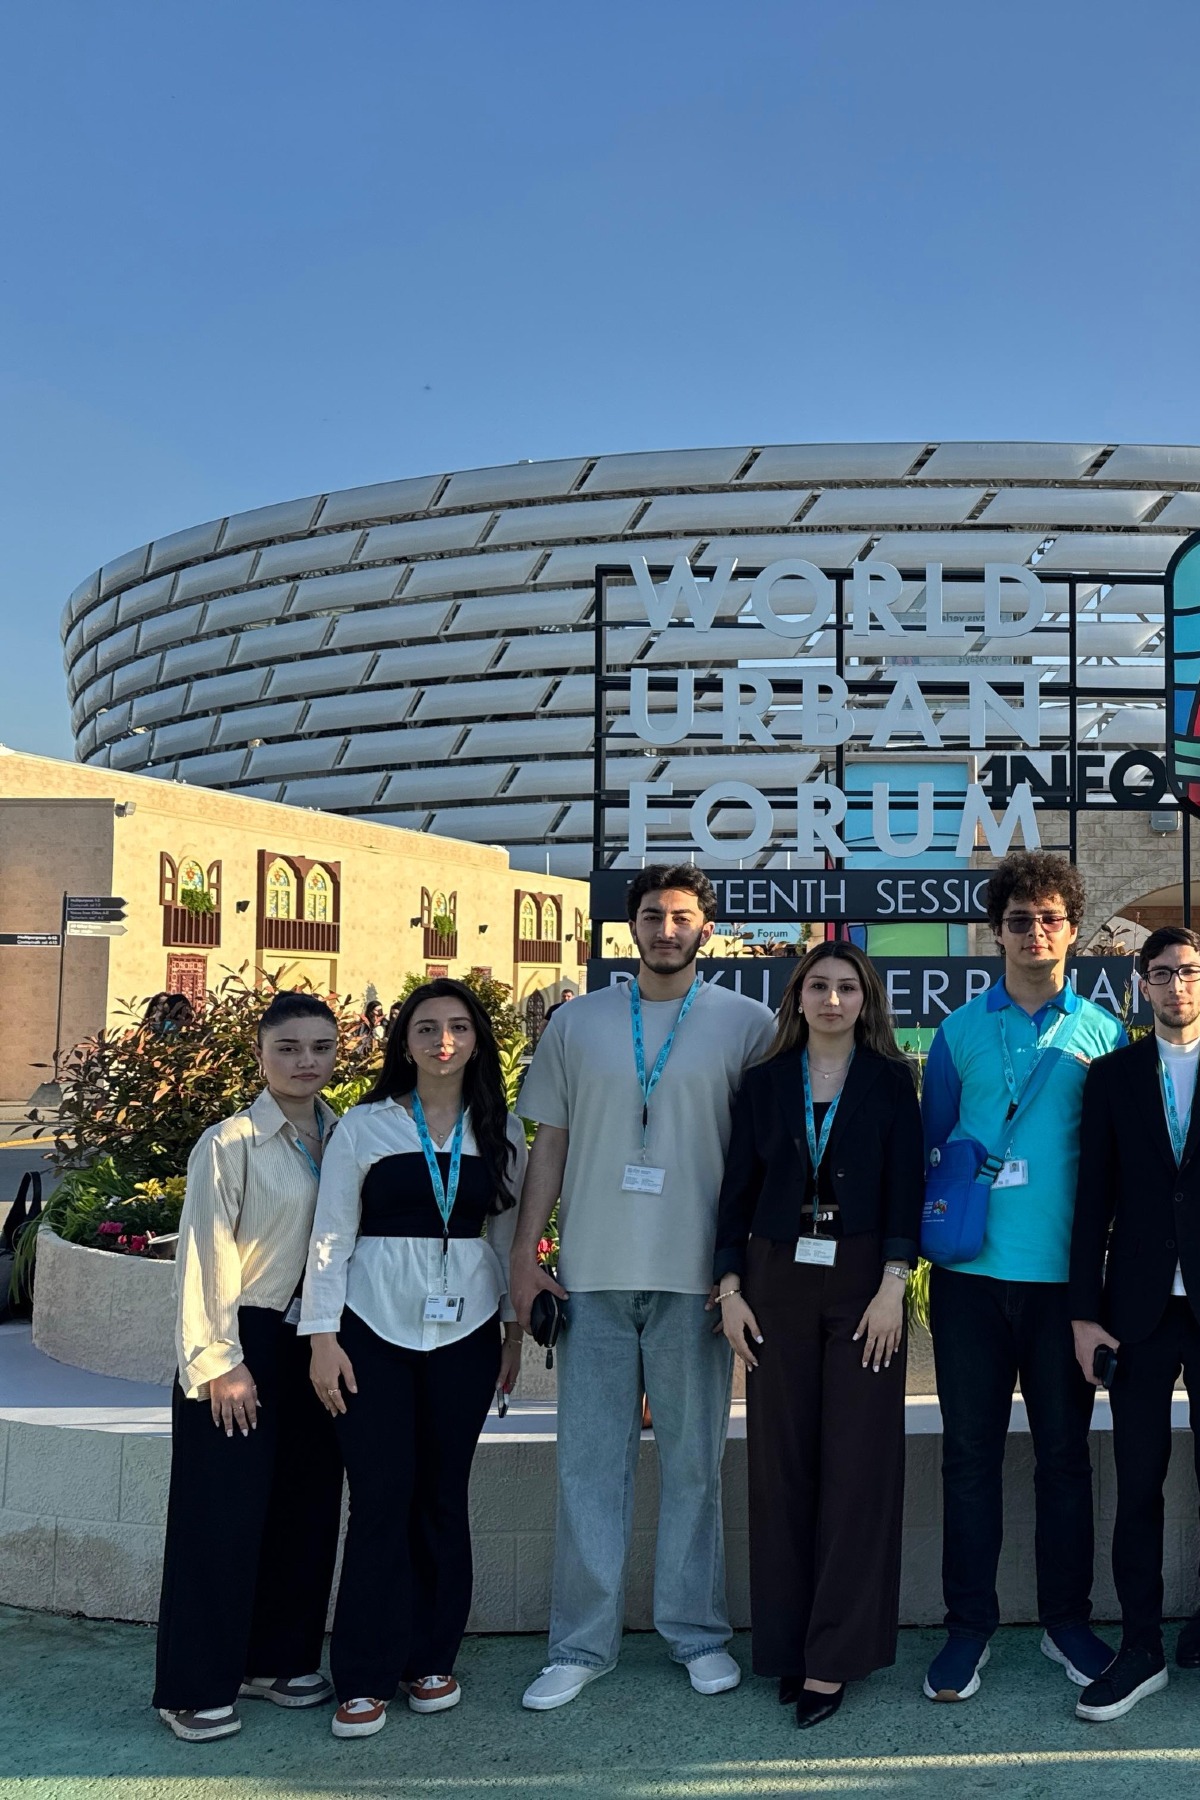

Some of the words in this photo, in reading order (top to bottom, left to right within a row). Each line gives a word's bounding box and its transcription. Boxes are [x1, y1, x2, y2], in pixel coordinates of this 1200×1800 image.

[628, 555, 1046, 638] WORLD
[630, 669, 1040, 748] URBAN
[628, 780, 1041, 860] FORUM
[627, 879, 846, 914] TEENTH
[876, 878, 990, 914] SESSI
[757, 928, 789, 938] Forum
